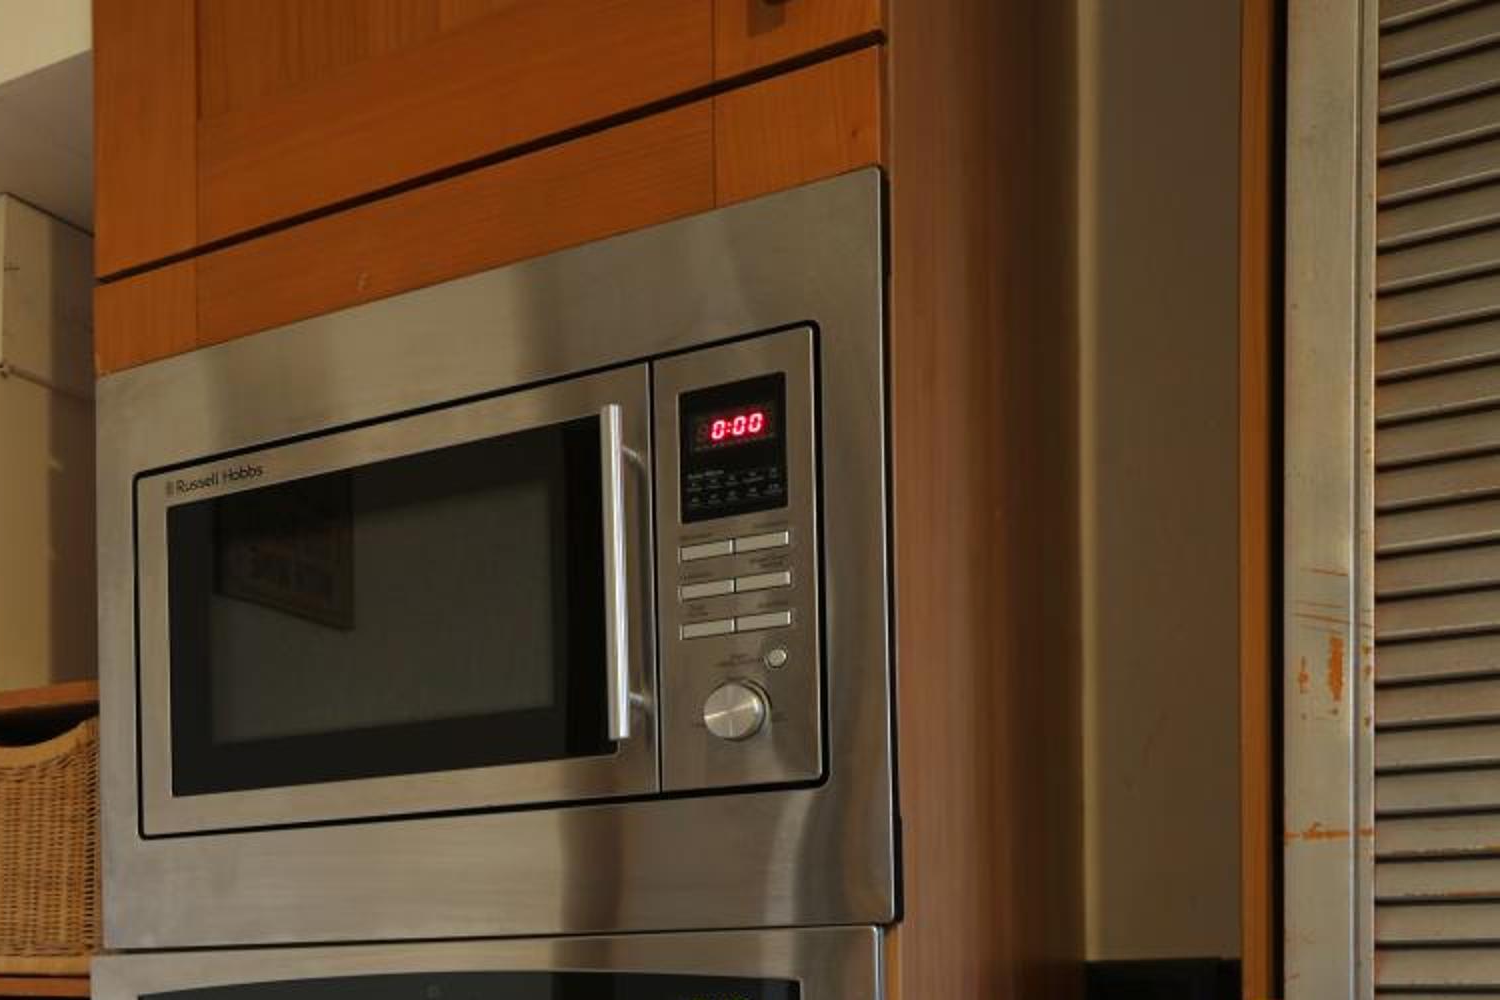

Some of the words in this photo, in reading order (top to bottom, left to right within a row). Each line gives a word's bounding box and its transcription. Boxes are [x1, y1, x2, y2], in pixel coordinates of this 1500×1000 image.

[710, 412, 764, 440] 0:00
[176, 471, 219, 494] Russell
[222, 464, 264, 484] Hobbs
